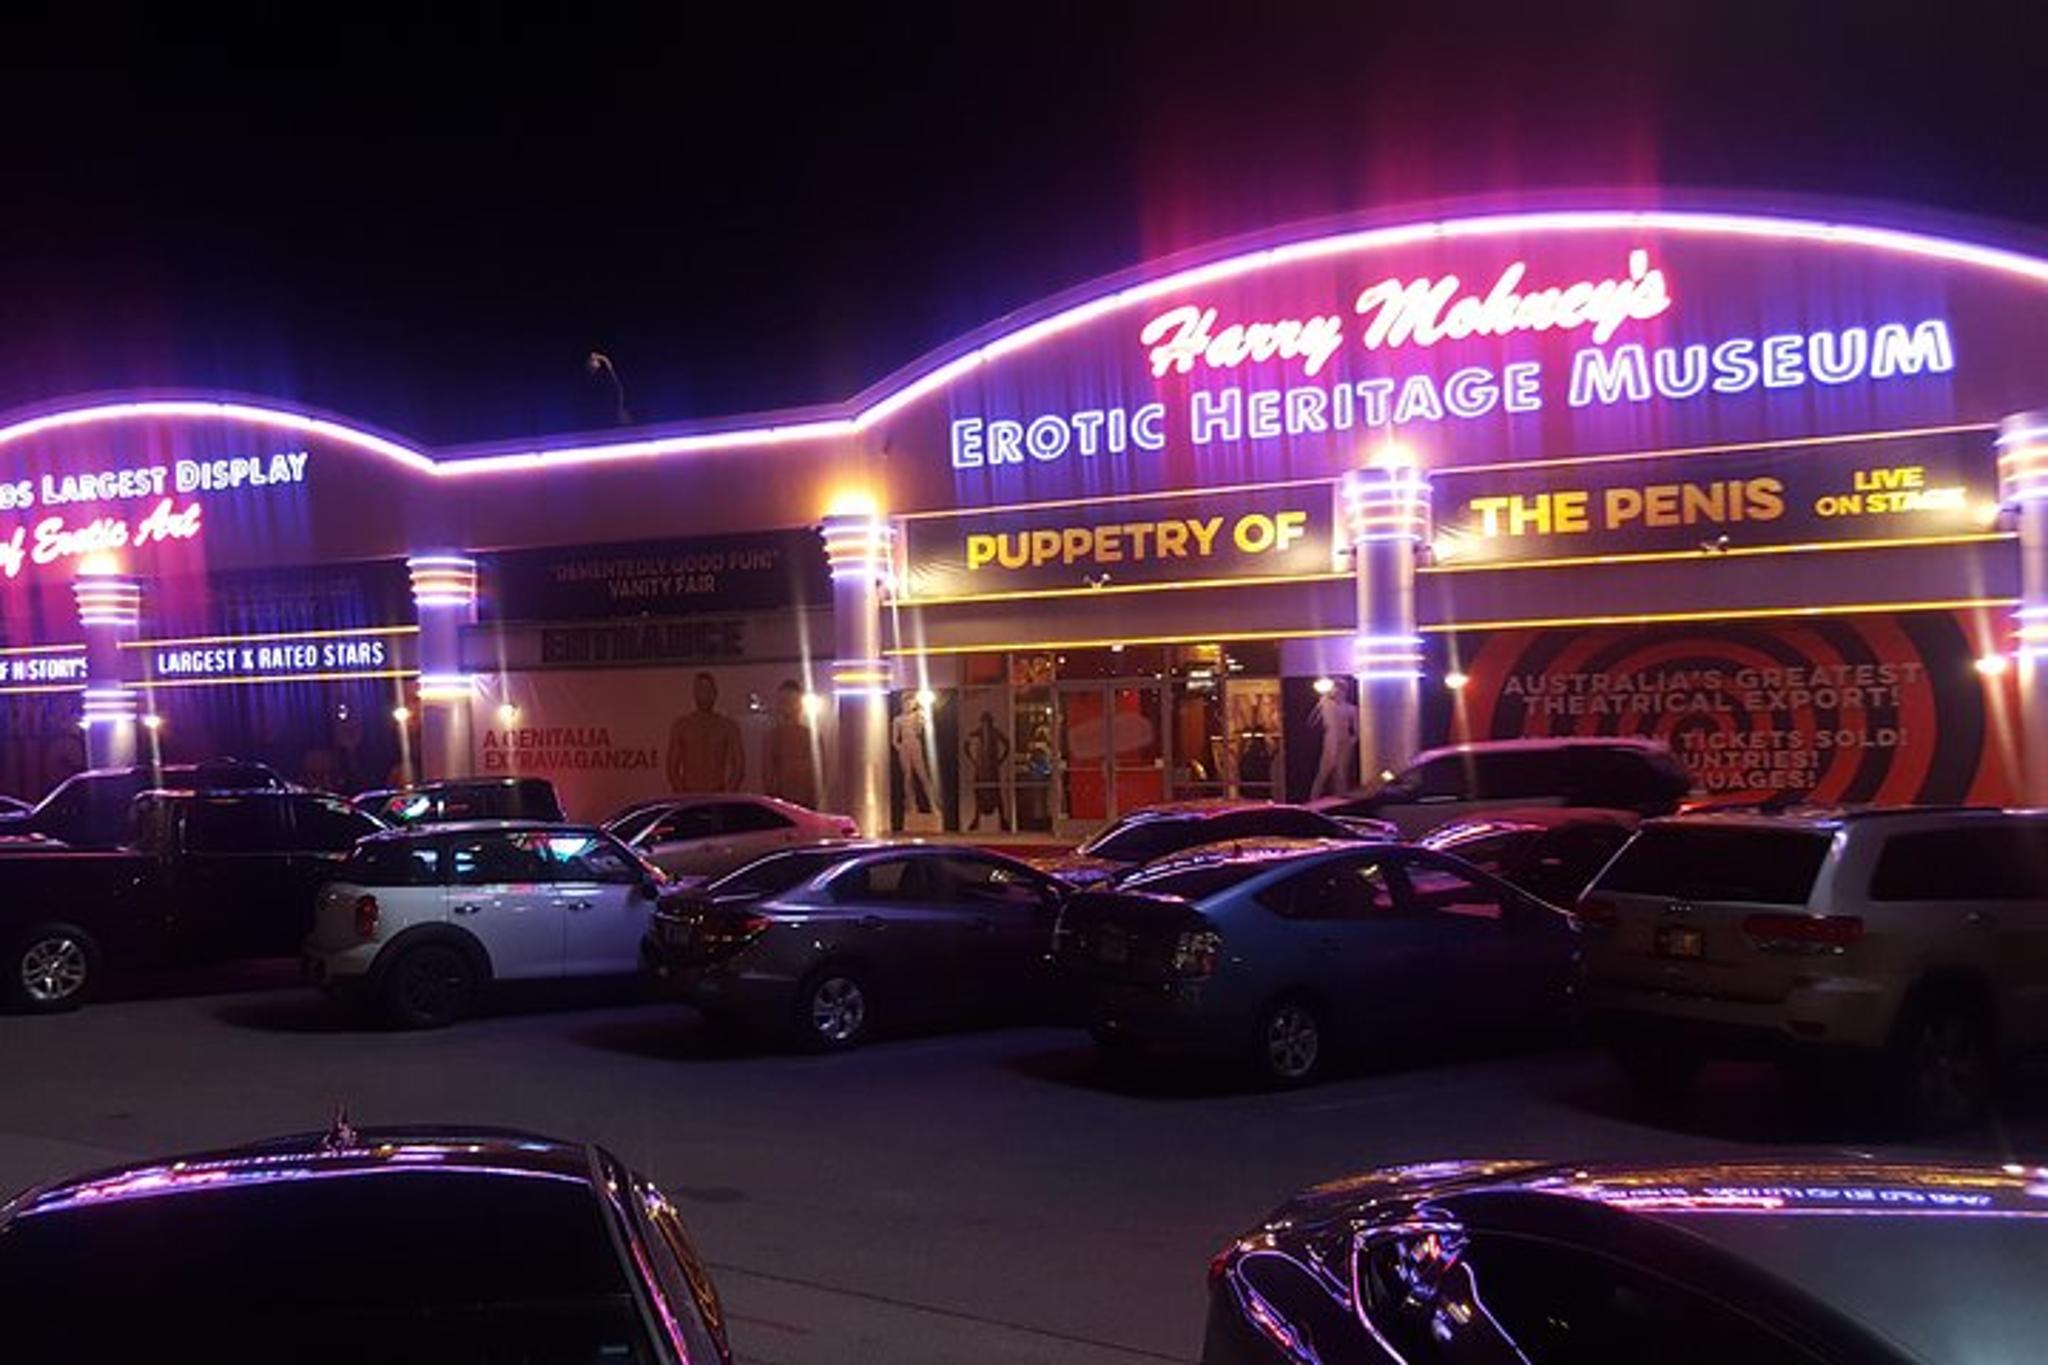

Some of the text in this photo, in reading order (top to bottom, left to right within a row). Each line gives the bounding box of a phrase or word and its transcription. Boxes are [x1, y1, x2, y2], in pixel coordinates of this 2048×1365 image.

[1141, 249, 1672, 377] Harry Mohney's
[951, 319, 1955, 469] EROTIC HERITAGE MUSEUM
[42, 465, 167, 505] LARGEST
[176, 452, 309, 492] DISPLAY
[1854, 465, 1925, 491] LIVE
[1471, 477, 1785, 537] THE PENIS
[1815, 494, 1862, 517] ON
[134, 499, 202, 547] Art
[966, 510, 1307, 571] PUPPETRY OF
[608, 574, 717, 598] VANITY FAIR
[158, 641, 385, 674] LARGEST X RATED STARS
[1504, 661, 1925, 697] AUSTRALIA'S GREATEST
[1525, 683, 1902, 716] THEATRICAL EXPORT!
[483, 732, 499, 748] A
[1680, 729, 1801, 749] TICKETS
[1817, 728, 1908, 748] SOLD!
[1682, 750, 1818, 770] UNTRIES!
[1694, 769, 1816, 791] UAGES!
